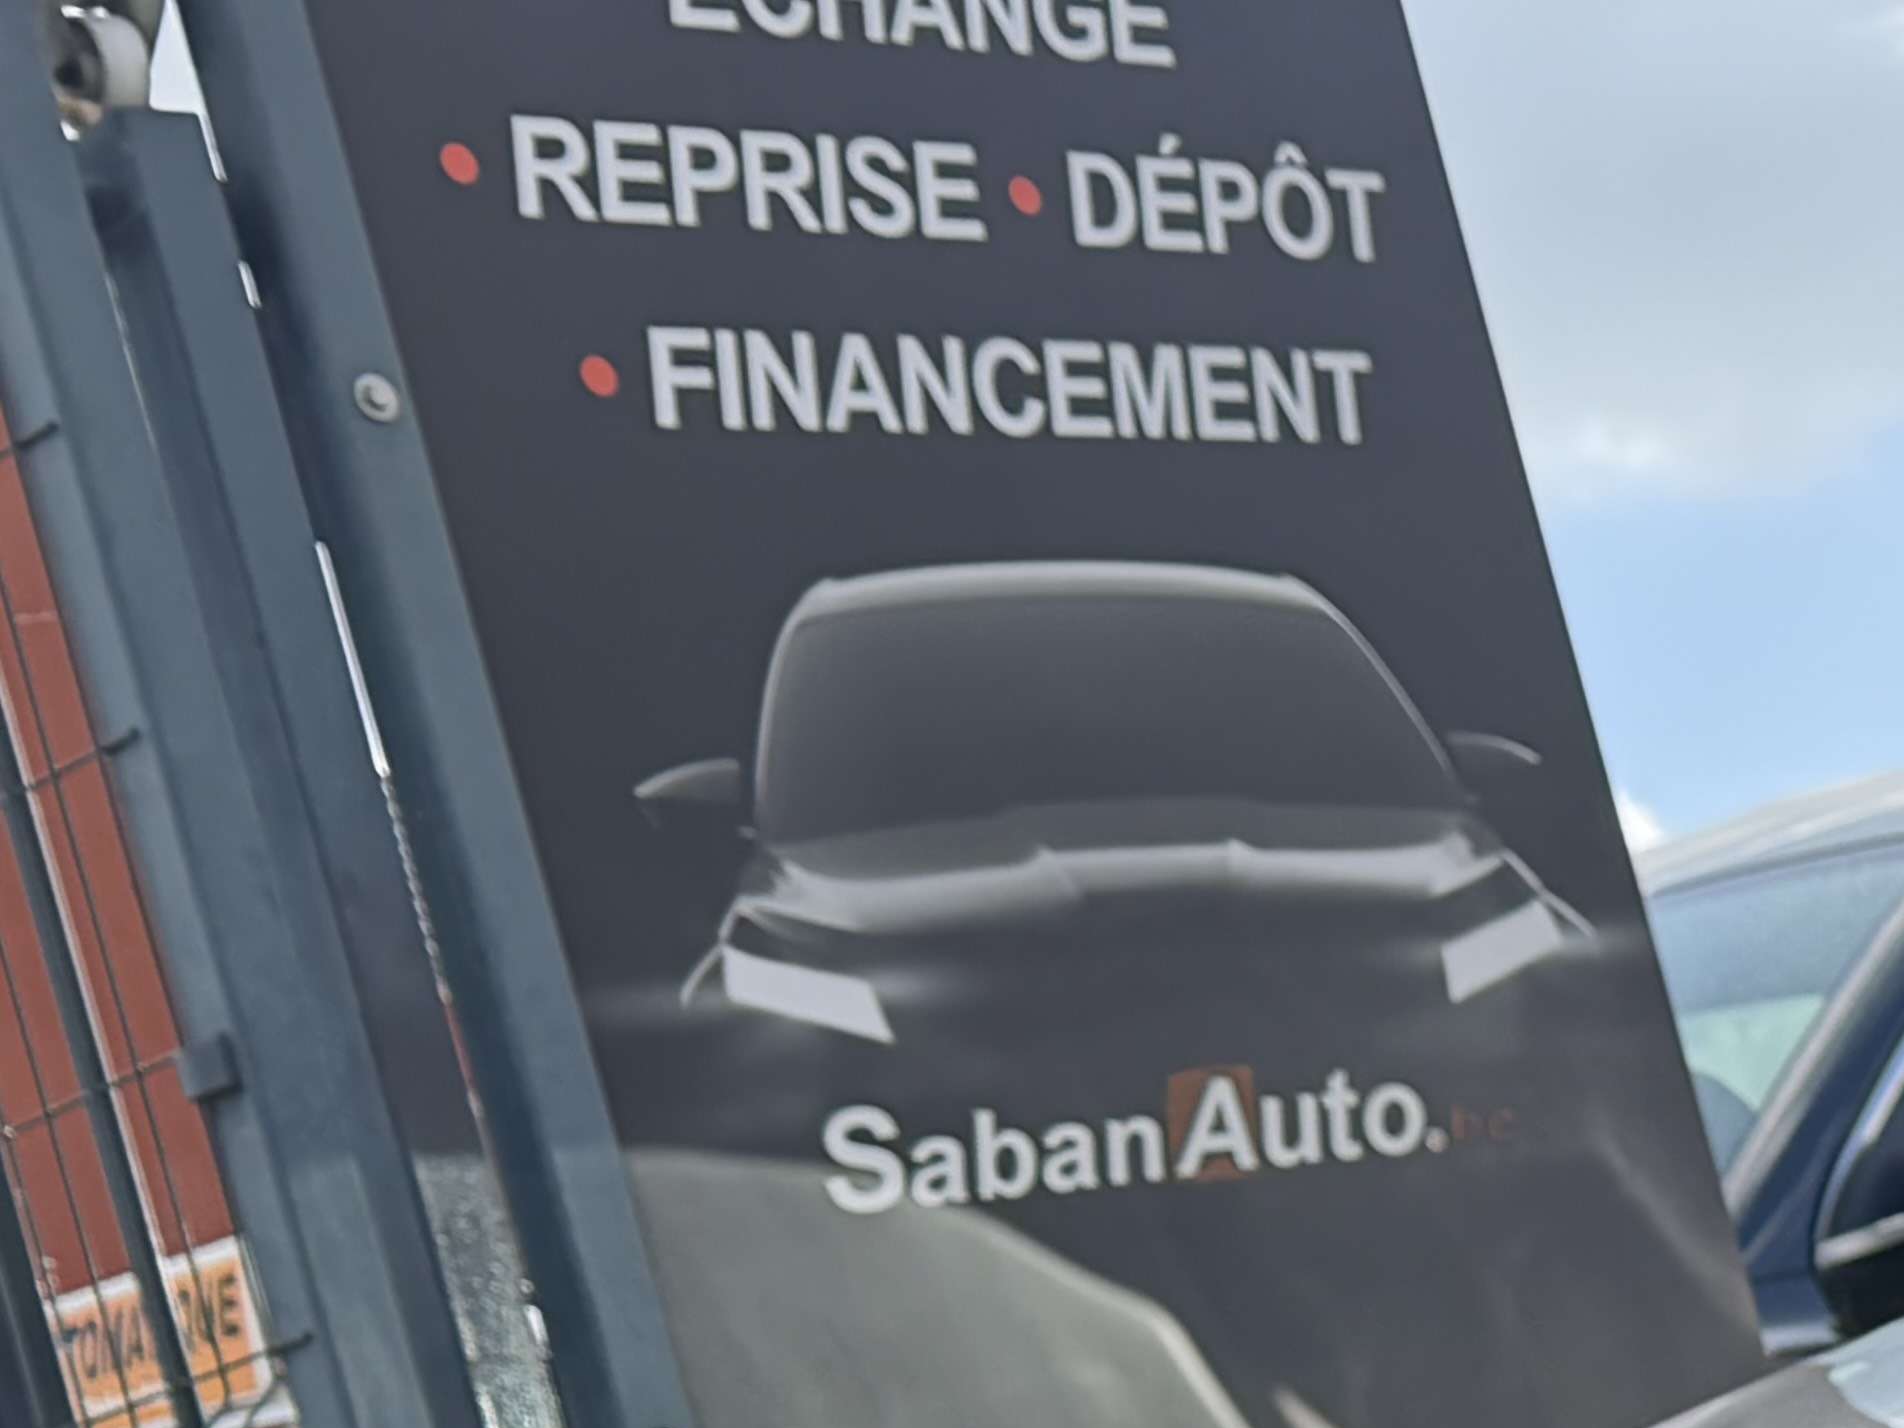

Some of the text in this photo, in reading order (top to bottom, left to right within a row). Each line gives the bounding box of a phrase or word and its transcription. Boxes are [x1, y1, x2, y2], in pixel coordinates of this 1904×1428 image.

[509, 113, 1386, 263] REPRISE DÉPÔT
[646, 325, 1372, 446] FINANCEMENT
